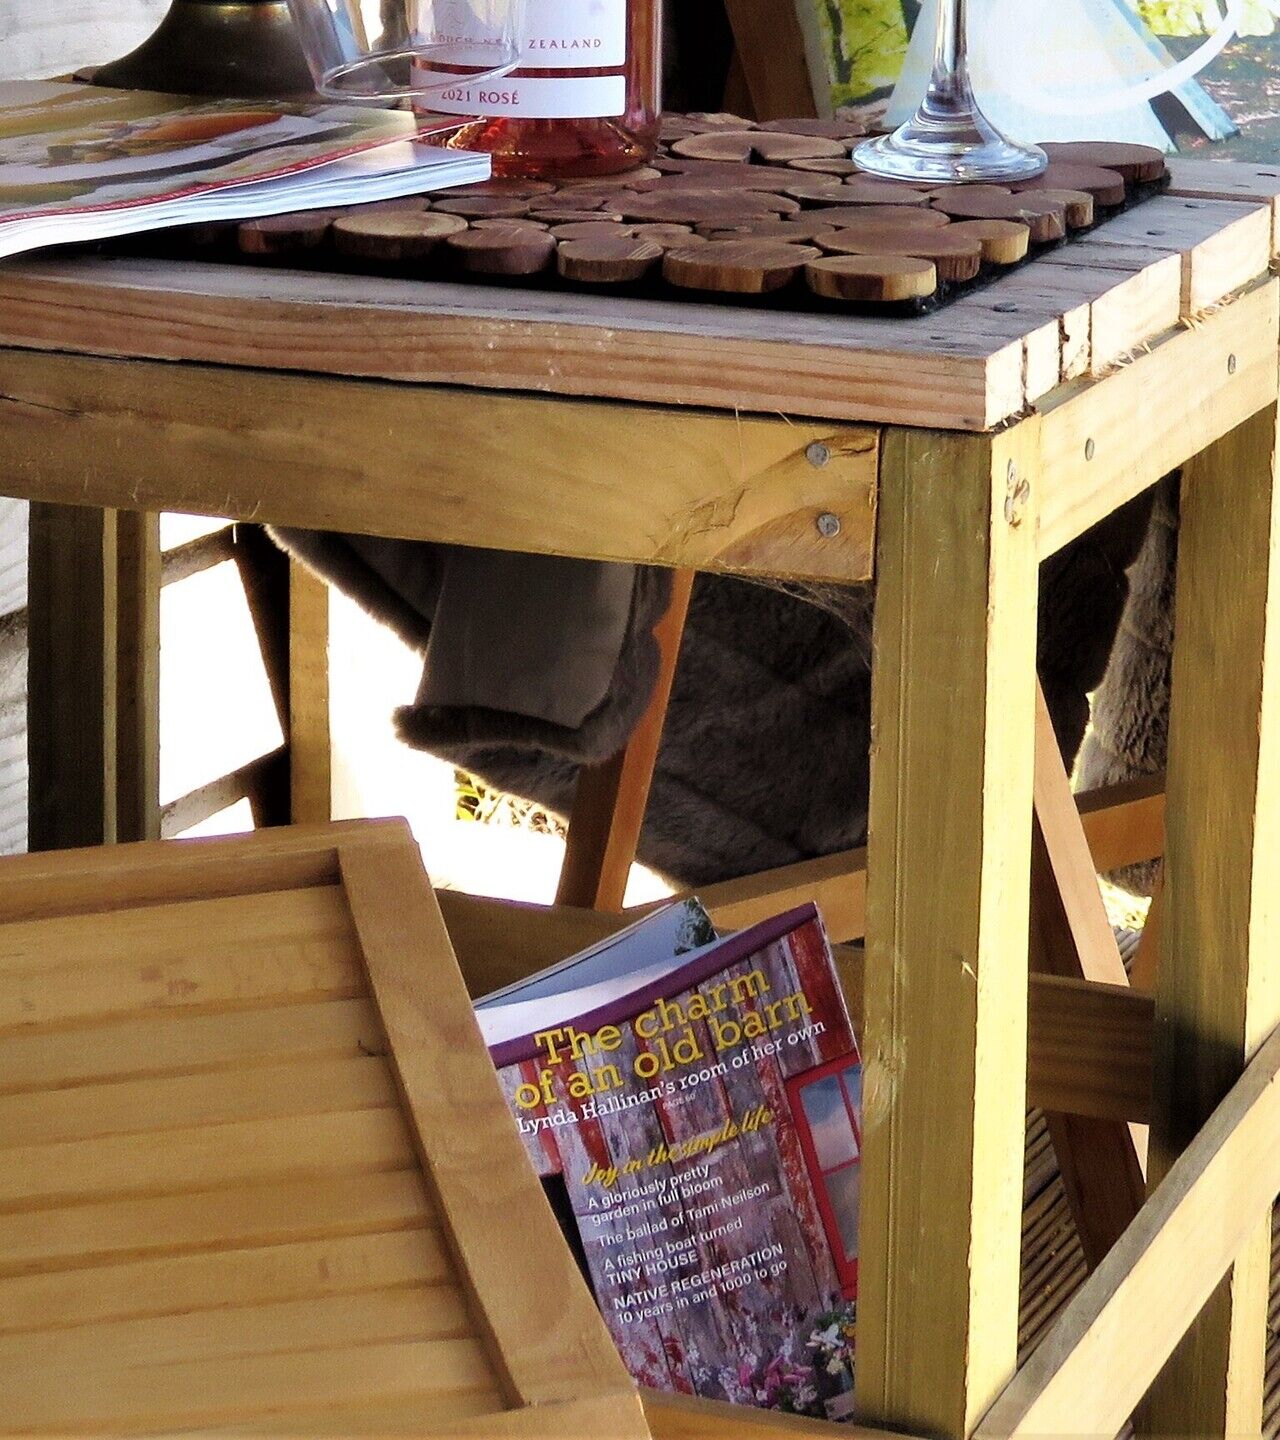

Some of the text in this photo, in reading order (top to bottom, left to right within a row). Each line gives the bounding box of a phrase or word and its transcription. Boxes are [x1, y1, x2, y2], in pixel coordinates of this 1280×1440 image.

[528, 38, 602, 50] ZEALAND
[441, 88, 520, 105] 2021 ROSÉ
[533, 968, 770, 1066] The charm
[515, 991, 813, 1109] of an old barn
[516, 1020, 827, 1137] Lynda Hallinan's room of her own
[582, 1104, 776, 1188] Joy in the simple life
[587, 1164, 710, 1210] A gloriously pretty
[592, 1175, 724, 1227] garden in full bloom
[598, 1181, 771, 1248] The ballad of Tami Neilson
[604, 1216, 744, 1271] A fishing boat turned
[606, 1248, 699, 1287] TINY HOUSE
[613, 1242, 785, 1310] NATIVE REGENERATION
[618, 1260, 789, 1325] 10 years in and 1000 to go
